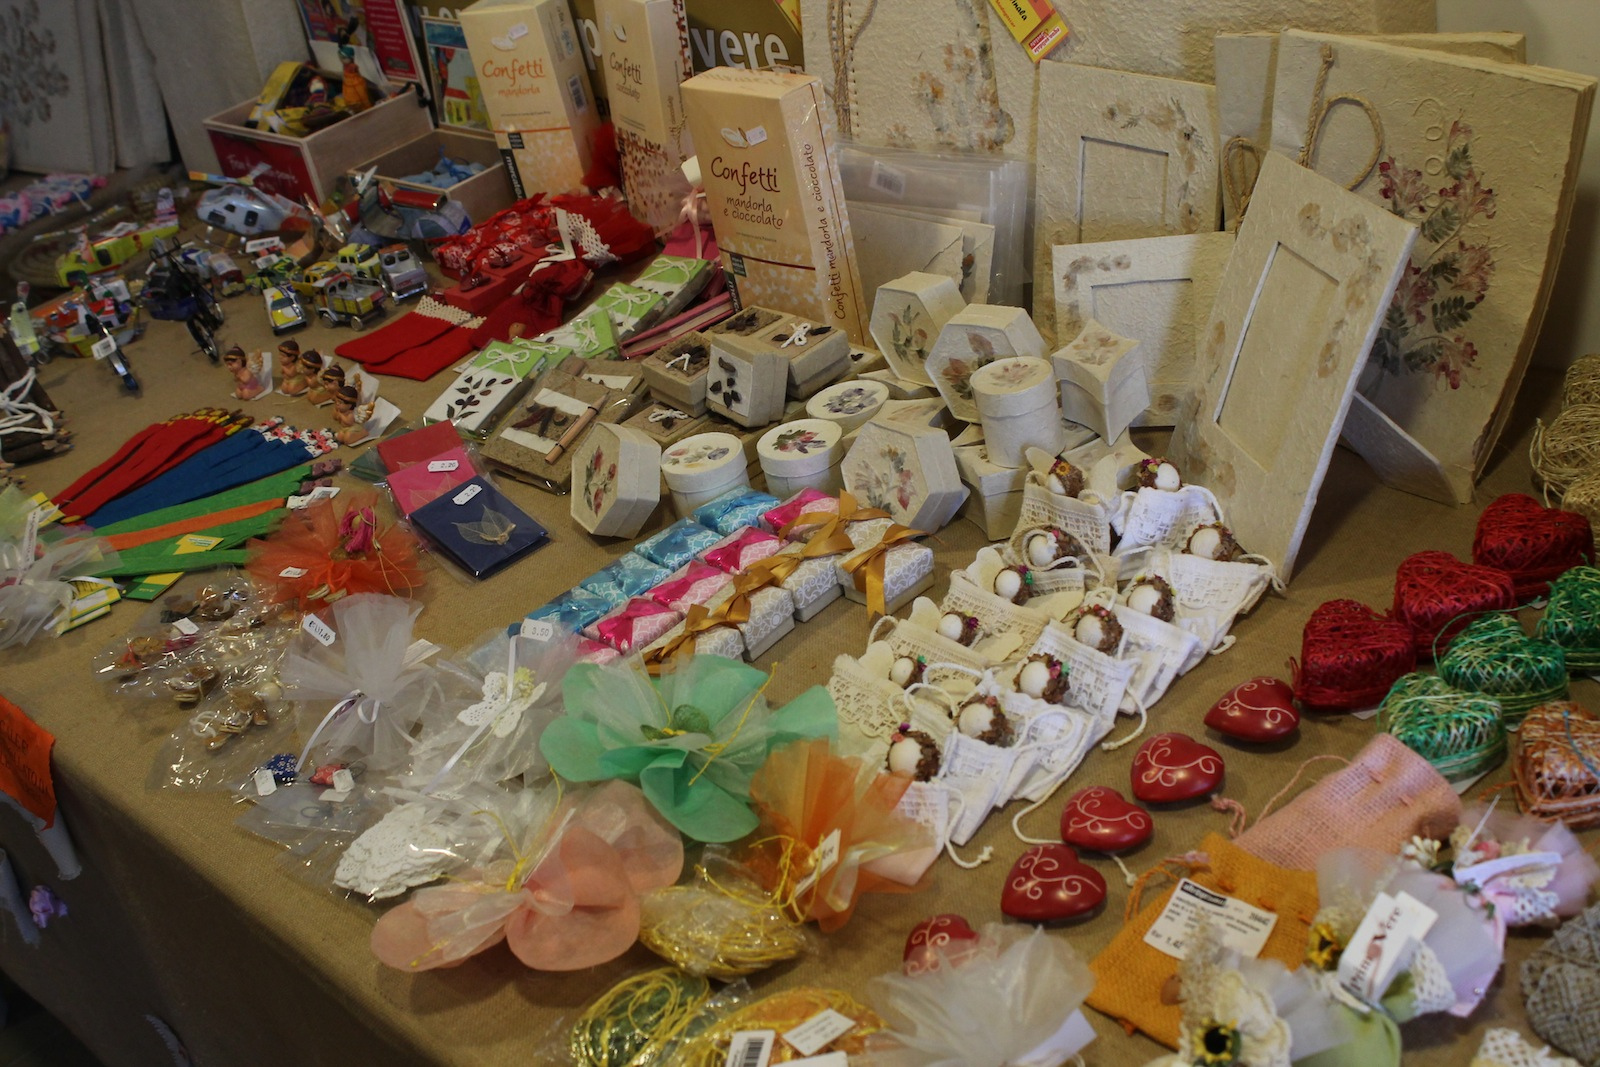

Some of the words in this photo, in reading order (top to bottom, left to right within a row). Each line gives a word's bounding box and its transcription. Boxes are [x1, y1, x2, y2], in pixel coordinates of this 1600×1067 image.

[482, 58, 545, 87] Confetti
[610, 52, 642, 85] Confetti
[498, 84, 541, 97] mandorla
[711, 156, 780, 196] Confetti
[803, 143, 823, 202] cioccolato
[723, 208, 729, 217] e
[732, 209, 784, 230] cioccolato
[726, 196, 773, 213] mandorla
[818, 205, 825, 213] e
[818, 217, 837, 269] mandorla
[829, 270, 848, 320] Confetti
[531, 626, 550, 637] 3.50
